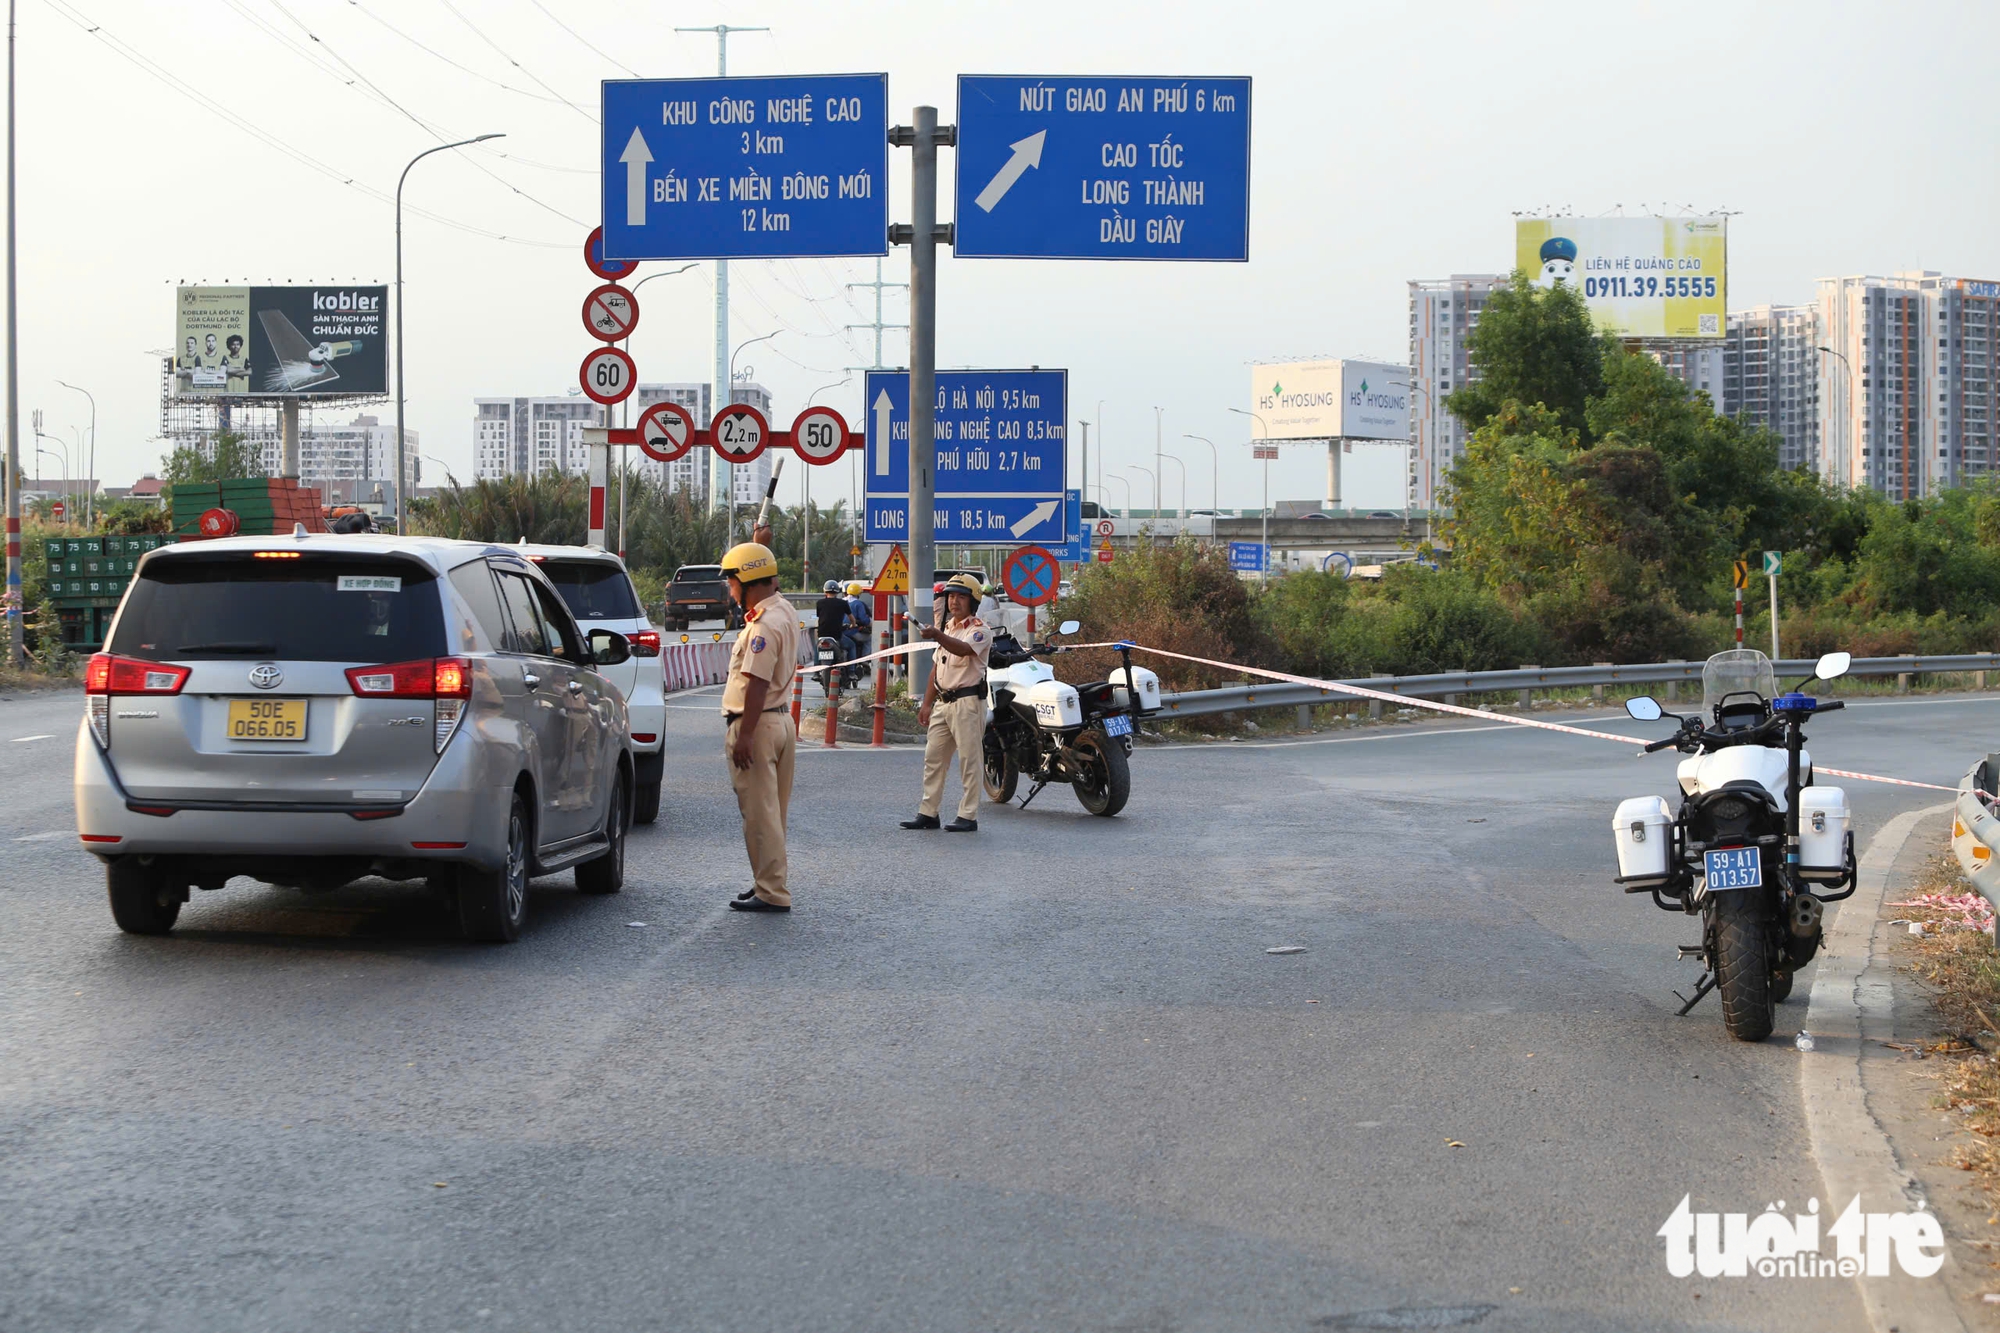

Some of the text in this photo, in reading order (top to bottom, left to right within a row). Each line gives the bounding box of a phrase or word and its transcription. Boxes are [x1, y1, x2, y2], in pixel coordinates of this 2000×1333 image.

[1020, 82, 1235, 112] NÚT GIAO AN PHÚ 6 km
[662, 94, 861, 126] KHU CÔNG NGHỆ CAO
[742, 130, 783, 154] 3 km
[1102, 133, 1184, 168] CAO TỐC
[654, 166, 870, 202] BẾN XE MIỀN ĐÔNG MỚI
[1082, 174, 1204, 205] LONG THÀNH
[742, 208, 790, 232] 12 km
[1100, 208, 1184, 244] DẦU GIÂY
[1586, 256, 1700, 272] LIÊN HỆ QUẢNG CÁO
[1586, 276, 1716, 298] 0911.39.5555
[1969, 281, 2000, 297] SAFIR
[312, 322, 378, 334] CHUẨN ĐỨC
[313, 314, 330, 322] SÀN
[332, 316, 359, 324] THẠCH
[596, 363, 620, 386] 60
[953, 386, 968, 409] HÀ
[976, 385, 994, 412] NỘI
[1002, 390, 1019, 410] 9,5
[1022, 390, 1040, 409] km
[1260, 392, 1333, 410] HS HYOSUNG
[1350, 392, 1404, 410] HS HYOSUNG
[808, 424, 832, 448] 50
[893, 422, 909, 440] KH
[960, 416, 990, 443] NGHỆ
[998, 421, 1020, 440] CAO
[1027, 421, 1044, 440] 8,5
[1046, 420, 1063, 440] km
[938, 447, 1040, 471] PHÚ HỮU 2,7 km
[874, 510, 904, 528] LONG
[960, 510, 982, 530] 18,5
[988, 510, 1005, 528] km
[50, 544, 60, 552] 75
[68, 543, 80, 551] 75
[88, 542, 98, 551] 75
[110, 542, 120, 550] 75
[128, 542, 139, 550] 75
[145, 541, 156, 549] 75
[52, 564, 60, 572] 10
[90, 563, 98, 571] 10
[742, 558, 767, 572] CSGT
[52, 582, 118, 592] 10 10 10 10
[250, 702, 283, 719] 50E
[1036, 703, 1056, 716] CSGT
[234, 720, 296, 737] 066.05
[1108, 716, 1126, 726] 59-A1
[1108, 724, 1132, 736] 017.16
[1713, 850, 1751, 869] 59-A1
[1710, 868, 1756, 888] 013.57
